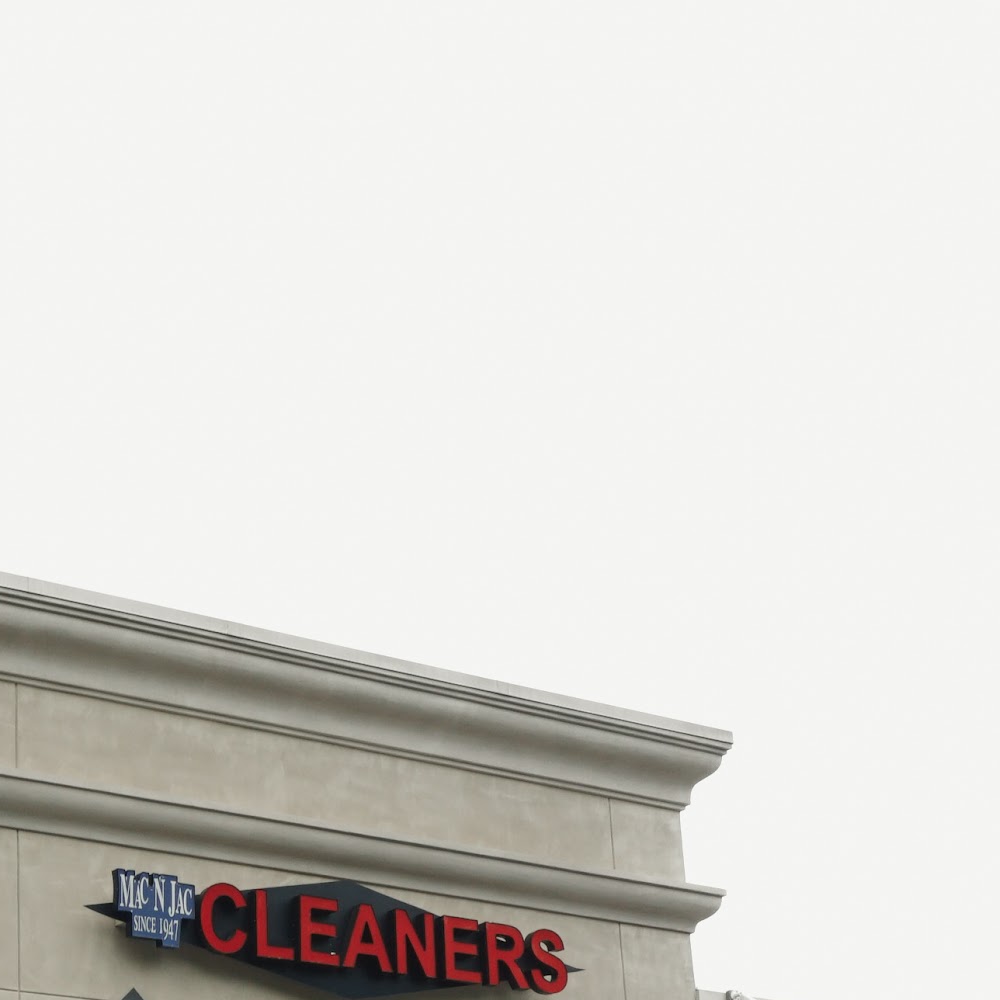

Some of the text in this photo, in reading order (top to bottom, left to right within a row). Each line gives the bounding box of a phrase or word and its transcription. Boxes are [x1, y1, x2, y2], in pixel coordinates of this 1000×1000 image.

[120, 874, 149, 909] MAC
[168, 881, 193, 917] JAC
[133, 915, 179, 941] SINCE 1947
[200, 882, 568, 995] CLEANERS
